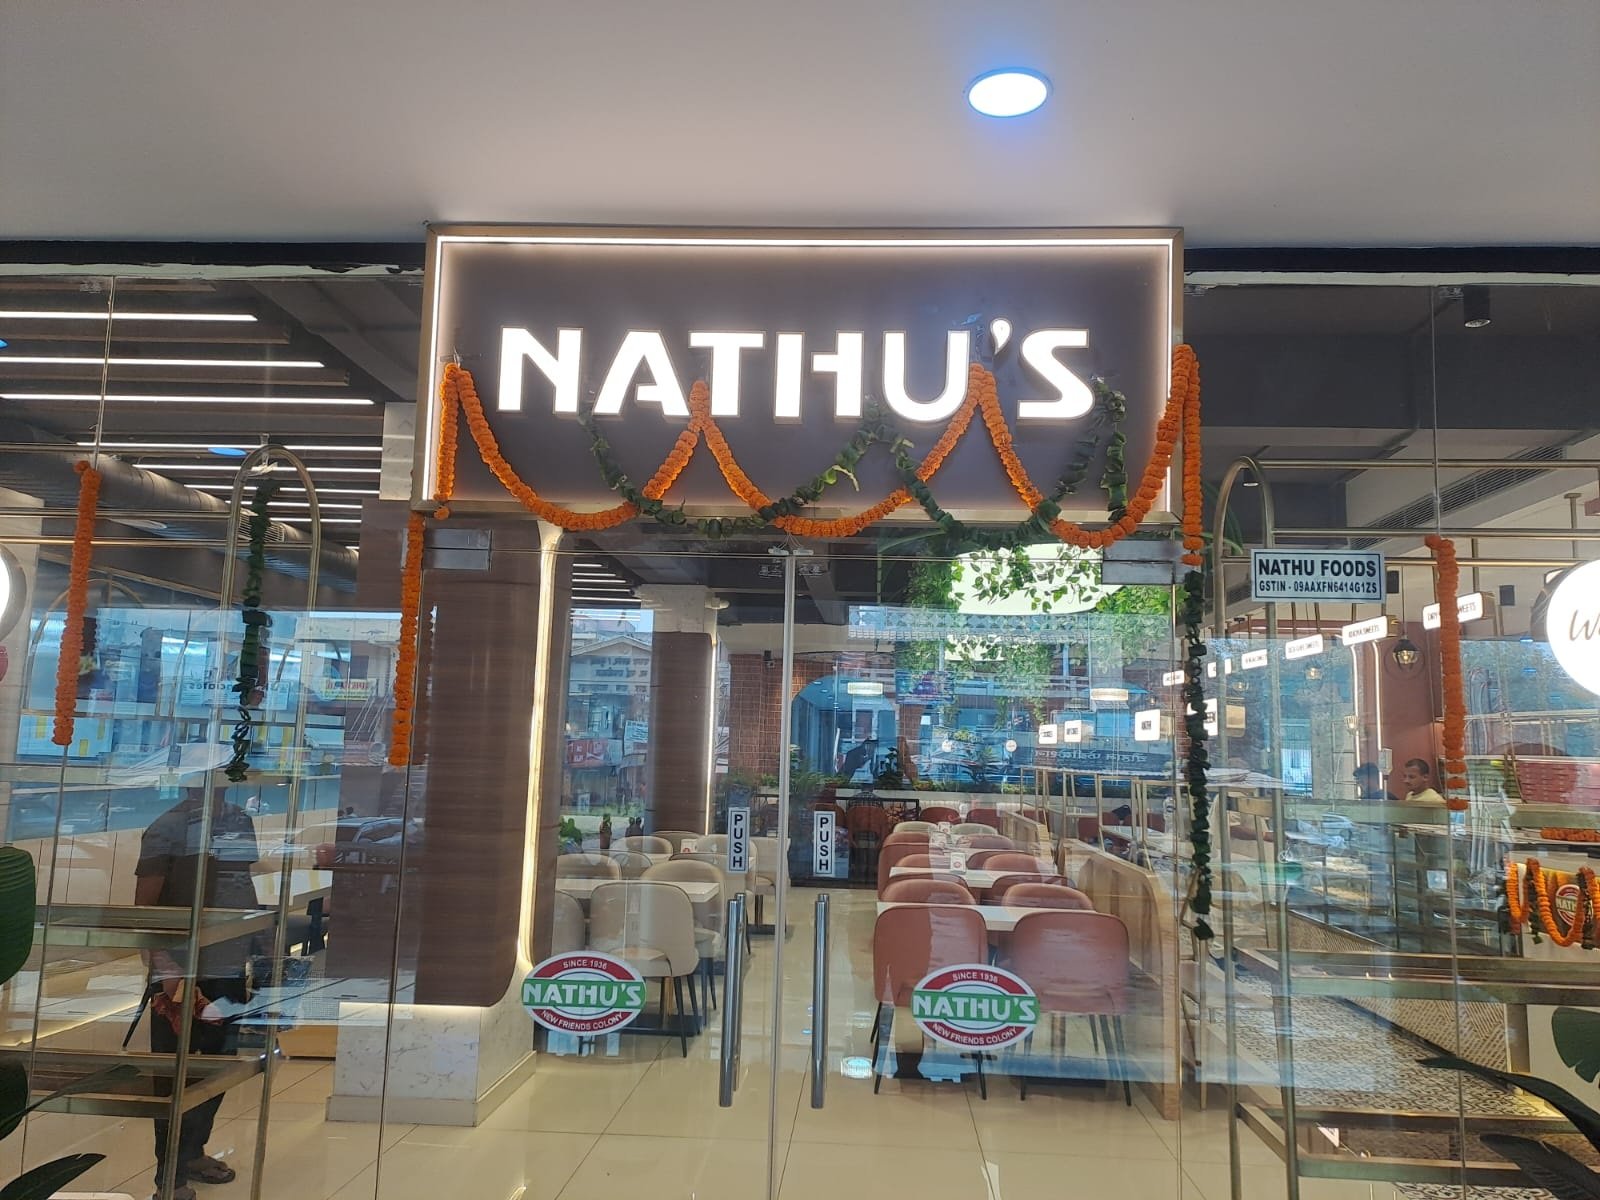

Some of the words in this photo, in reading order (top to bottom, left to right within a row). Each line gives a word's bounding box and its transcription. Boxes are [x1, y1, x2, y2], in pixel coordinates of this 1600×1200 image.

[497, 317, 1095, 423] NATHU'S
[1259, 559, 1315, 576] NATHU
[1321, 560, 1377, 578] FOODS
[1260, 581, 1286, 591] GSTIN
[732, 814, 744, 868] PUSH
[819, 817, 829, 871] PUSH
[563, 960, 588, 969] SINCE
[590, 960, 607, 970] 1936
[952, 972, 978, 981] SINCE
[522, 983, 642, 1006] NATHU'S
[541, 1008, 558, 1024] NEW
[558, 1018, 591, 1030] FRIENDS
[592, 1011, 623, 1030] COLONY
[913, 995, 1036, 1021] NATHU'S
[932, 1023, 950, 1038] NEW
[950, 1033, 985, 1045] FRIENDS
[986, 1027, 1017, 1044] COLONY
